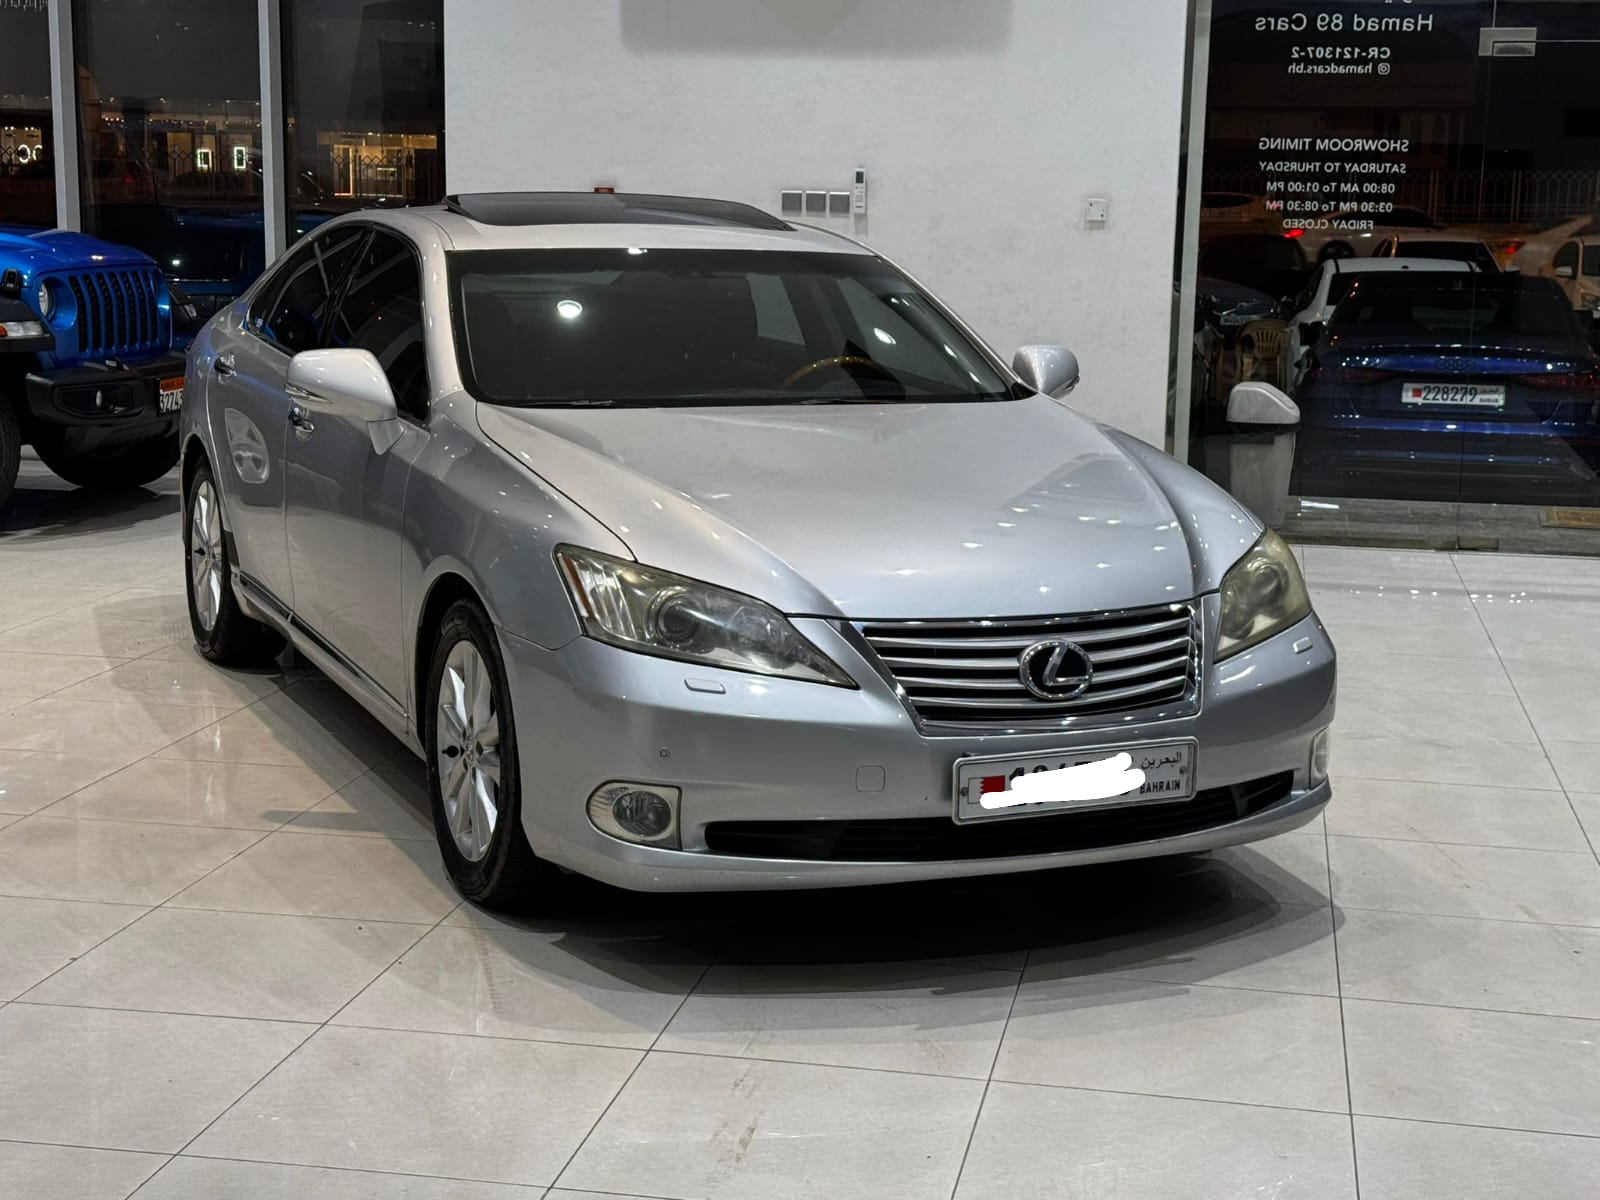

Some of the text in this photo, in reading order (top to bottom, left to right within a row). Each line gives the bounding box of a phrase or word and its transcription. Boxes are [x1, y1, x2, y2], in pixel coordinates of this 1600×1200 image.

[1422, 385, 1478, 402] 228279
[1141, 751, 1182, 769] البحرين
[1140, 780, 1181, 795] BAHRAIN
